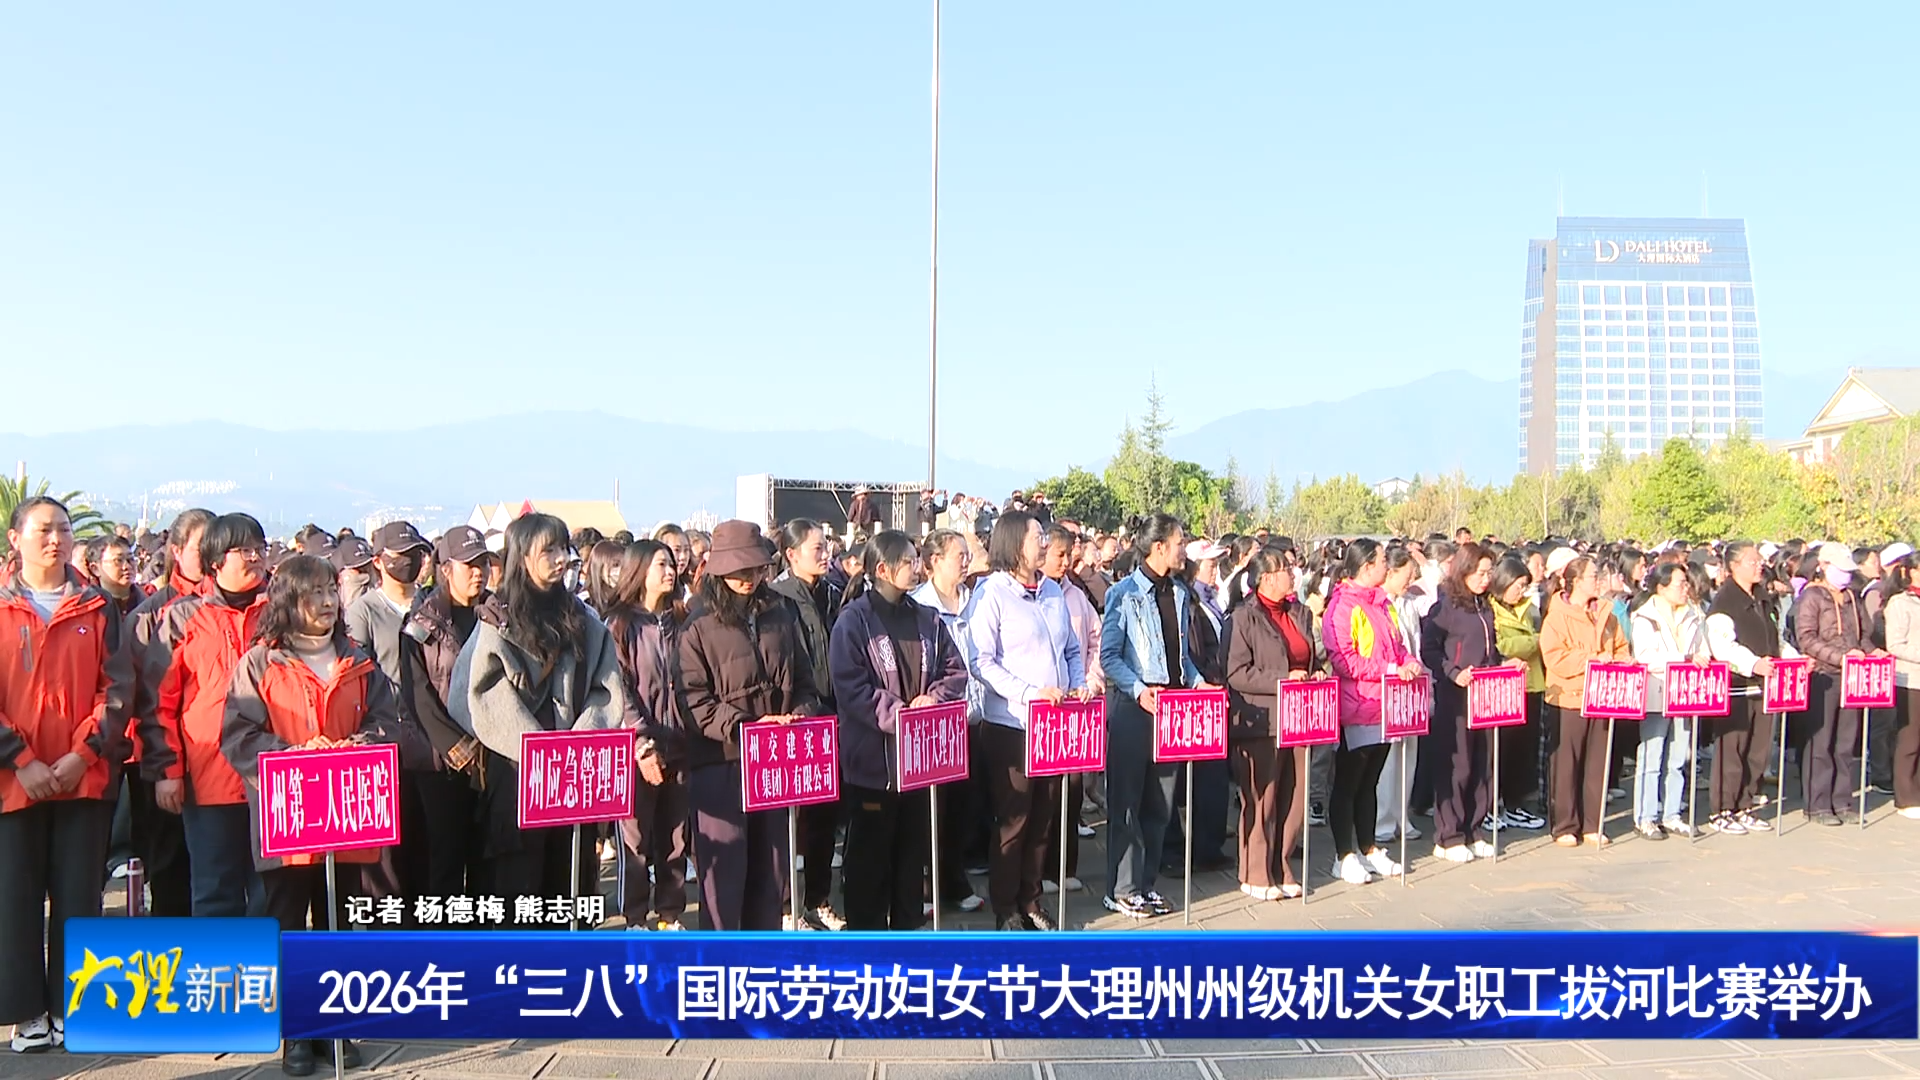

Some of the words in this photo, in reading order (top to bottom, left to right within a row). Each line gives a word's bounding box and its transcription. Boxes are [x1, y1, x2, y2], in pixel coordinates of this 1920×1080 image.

[1625, 240, 1660, 252] DALI
[1664, 240, 1713, 253] HOTEL
[1638, 253, 1700, 264] 大理国际大酒店
[1588, 670, 1643, 710] 州检验检测院
[1669, 669, 1725, 707] 州公积金中心
[1769, 664, 1805, 702] 州法院
[1847, 662, 1891, 698] 州医保局
[1160, 699, 1223, 748] 州交通运输局
[1387, 682, 1427, 727] 州融媒体中心
[749, 728, 832, 763] 州交建实业
[1033, 709, 1101, 764] 农行大理分行
[528, 744, 628, 811] 州应急管理局
[754, 762, 832, 799] （集团）有限公司
[270, 759, 391, 839] 州第二人民医院
